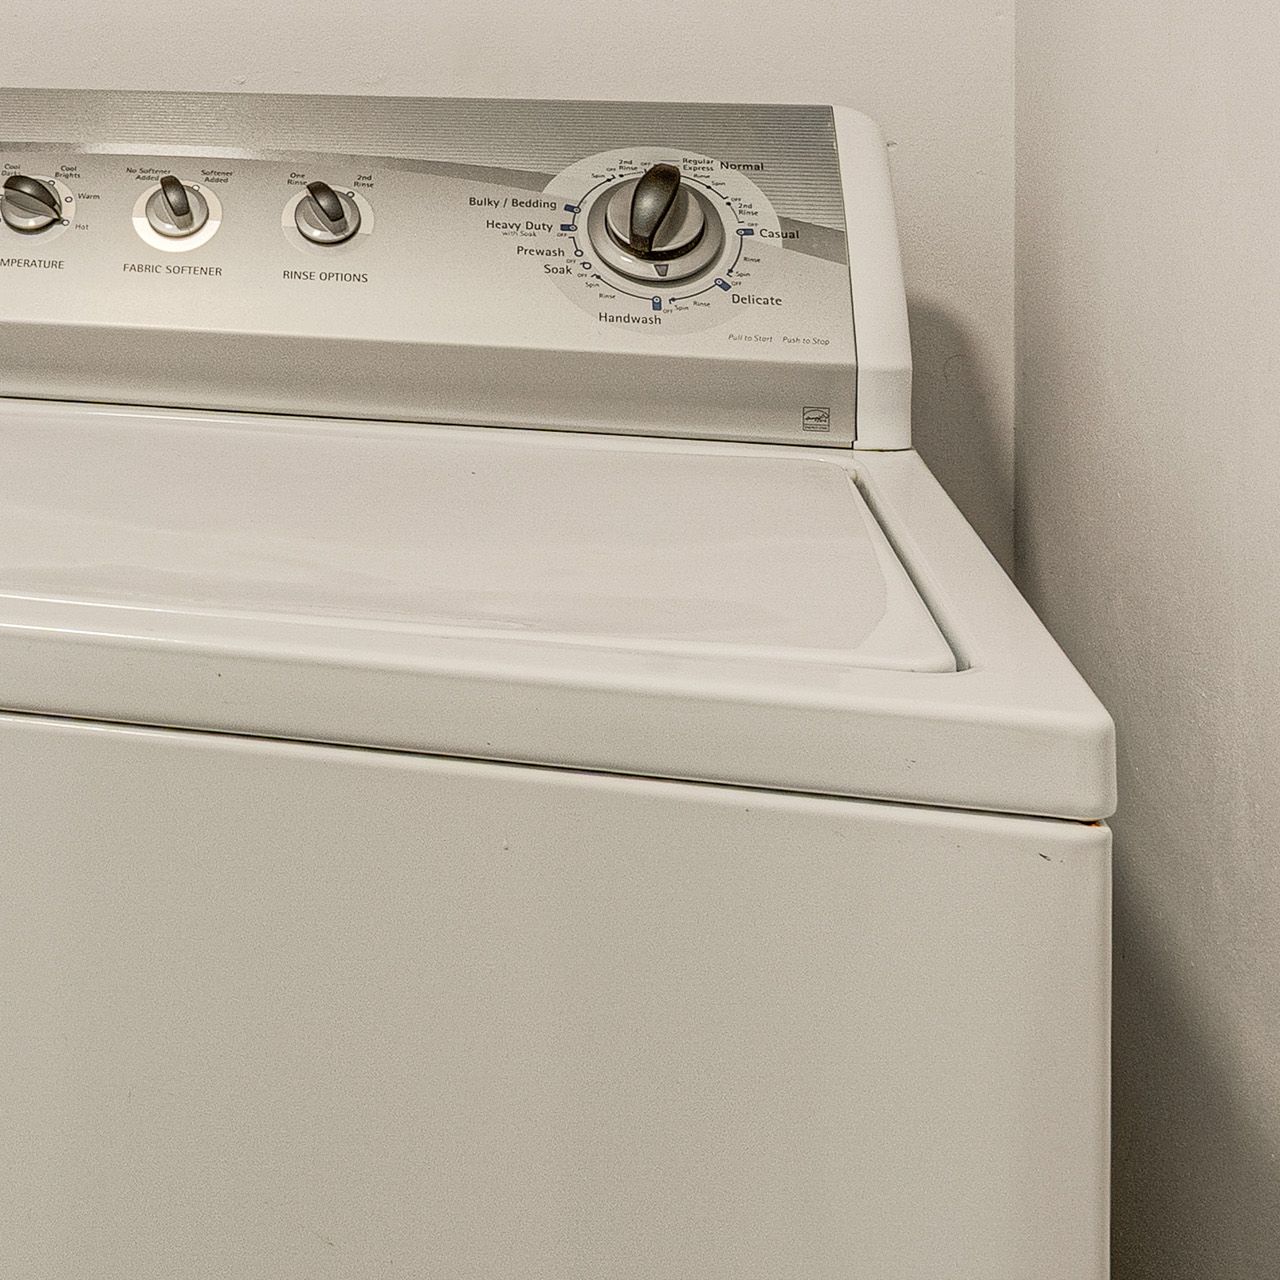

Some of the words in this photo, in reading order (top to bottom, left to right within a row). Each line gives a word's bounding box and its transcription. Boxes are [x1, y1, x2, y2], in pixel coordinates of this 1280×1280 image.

[683, 164, 714, 172] Express
[720, 162, 764, 171] Normal
[469, 197, 500, 208] Bulky
[503, 198, 507, 207] /
[512, 199, 557, 210] Bedding
[75, 223, 89, 231] Hot
[486, 220, 521, 231] Heavy
[526, 221, 553, 232] Duty
[760, 229, 800, 239] Casual
[517, 246, 564, 257] Prewash
[123, 264, 162, 274] FABRIC
[166, 265, 222, 276] SOFTENER
[544, 264, 572, 275] Soak
[283, 271, 316, 281] RINSE
[319, 272, 368, 283] OPTIONS
[732, 294, 783, 306] Delicate
[599, 313, 662, 324] Handwash
